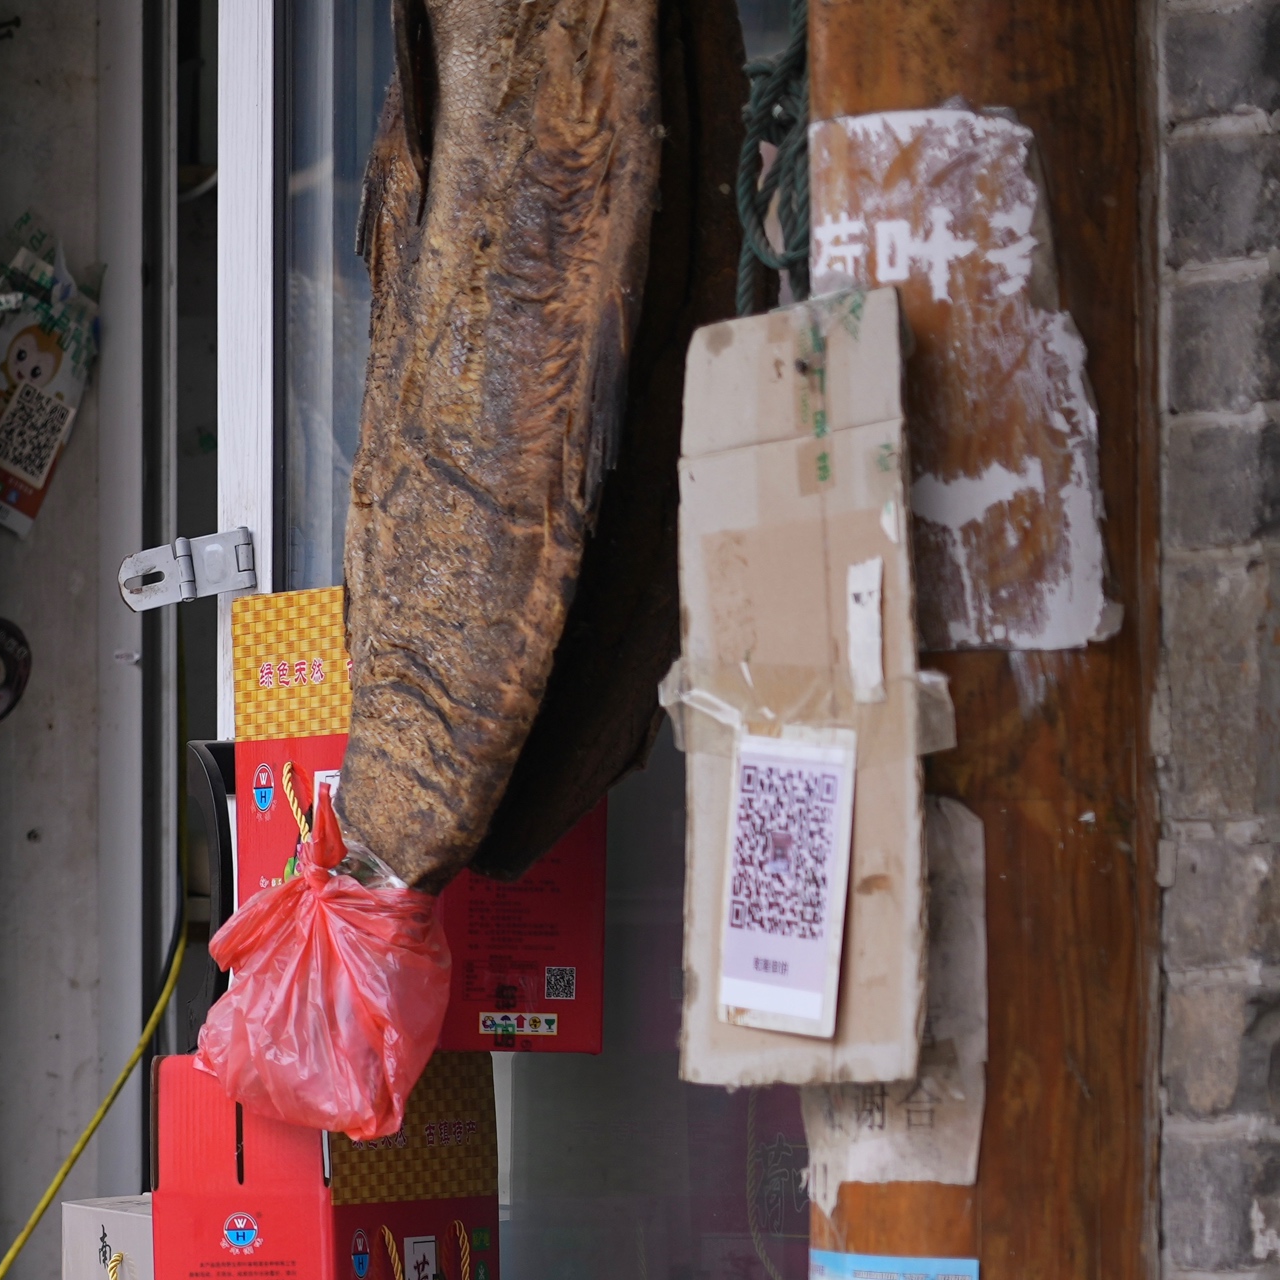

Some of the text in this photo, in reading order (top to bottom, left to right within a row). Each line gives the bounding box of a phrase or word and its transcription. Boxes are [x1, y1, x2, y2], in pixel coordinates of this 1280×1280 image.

[259, 658, 325, 689] 绿色天然
[258, 772, 268, 786] W
[260, 791, 267, 804] H
[234, 1218, 247, 1229] W
[236, 1231, 246, 1241] H
[356, 1238, 364, 1252] W
[357, 1257, 365, 1271] H
